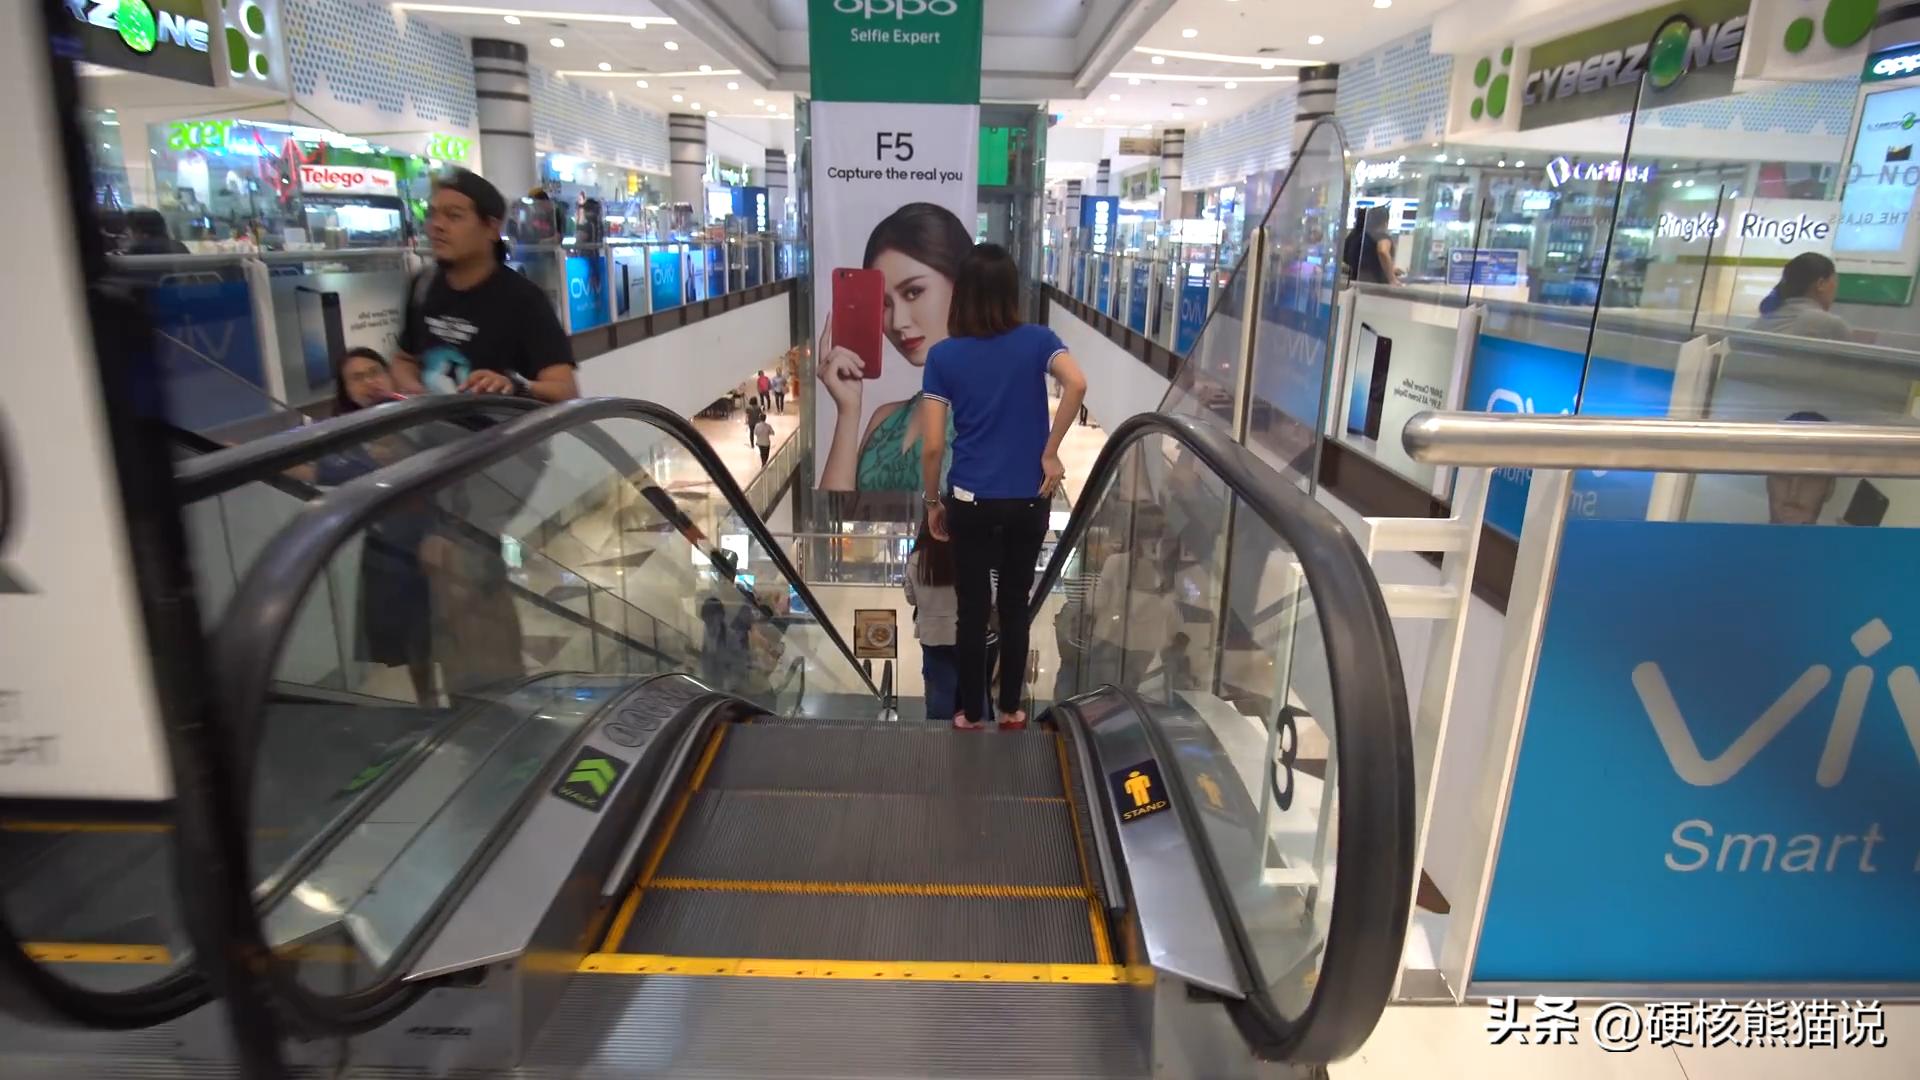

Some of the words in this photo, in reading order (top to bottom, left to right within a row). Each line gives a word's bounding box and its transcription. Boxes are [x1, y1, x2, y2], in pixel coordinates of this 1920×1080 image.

[850, 27, 890, 42] Selfie
[893, 29, 940, 45] Expert
[1523, 14, 1748, 105] CYBERZONE
[169, 119, 232, 150] acer
[876, 132, 914, 161] F5
[302, 167, 364, 188] Telego
[827, 166, 883, 182] Capture
[885, 166, 908, 180] the
[910, 168, 937, 180] real
[939, 171, 963, 184] you
[1657, 212, 1724, 243] Ringke
[1739, 211, 1830, 245] Ringke
[1631, 617, 1920, 788] vi
[1123, 800, 1167, 820] STAND
[1664, 819, 1885, 872] Smart
